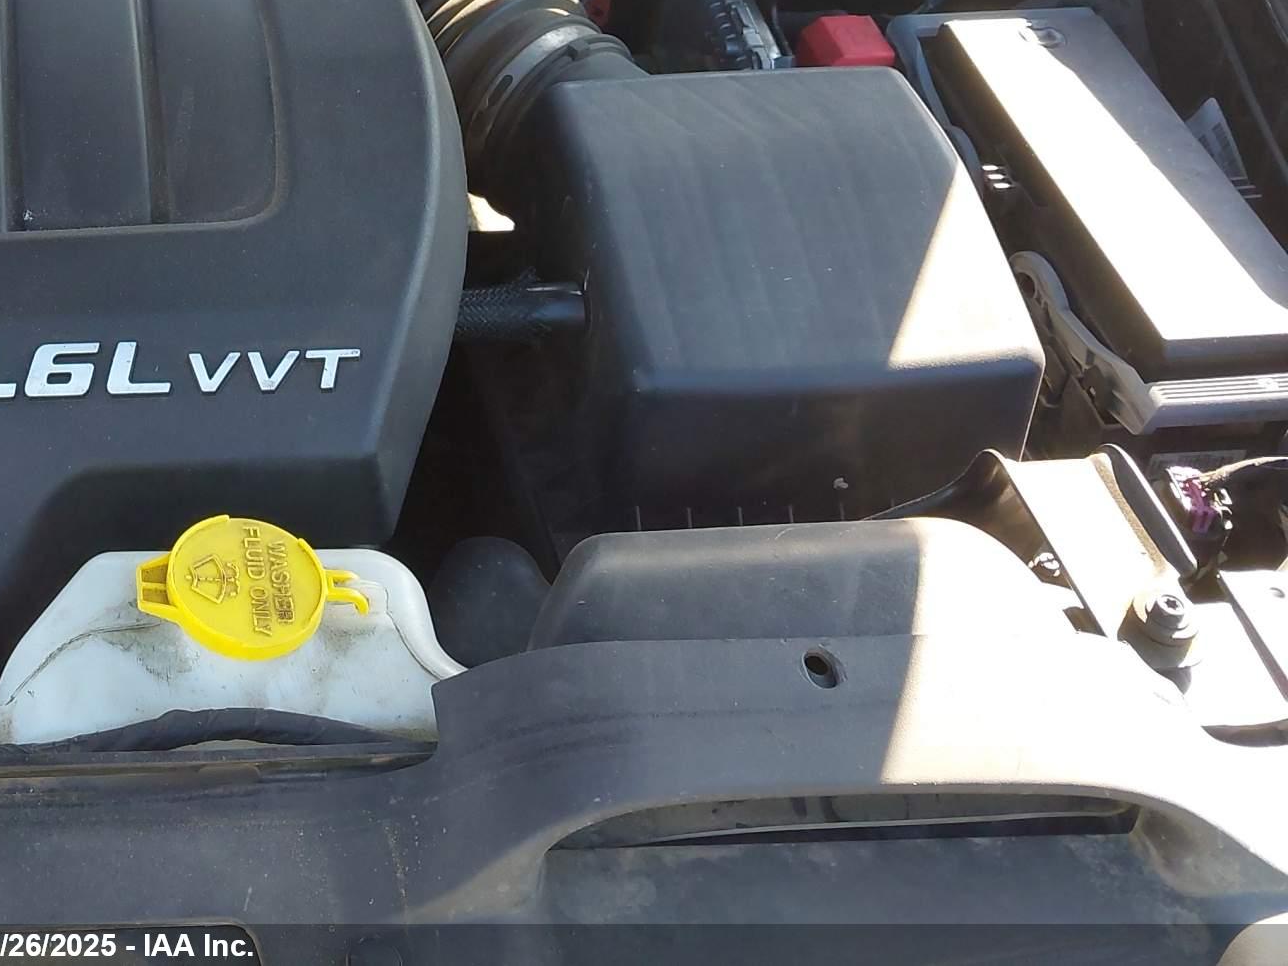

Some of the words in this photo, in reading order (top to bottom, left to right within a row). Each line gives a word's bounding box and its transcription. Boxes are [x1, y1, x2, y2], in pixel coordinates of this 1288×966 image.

[188, 348, 361, 393] VVT
[242, 525, 266, 581] FLUID
[266, 539, 295, 626] WASHER
[250, 585, 273, 637] ONLY
